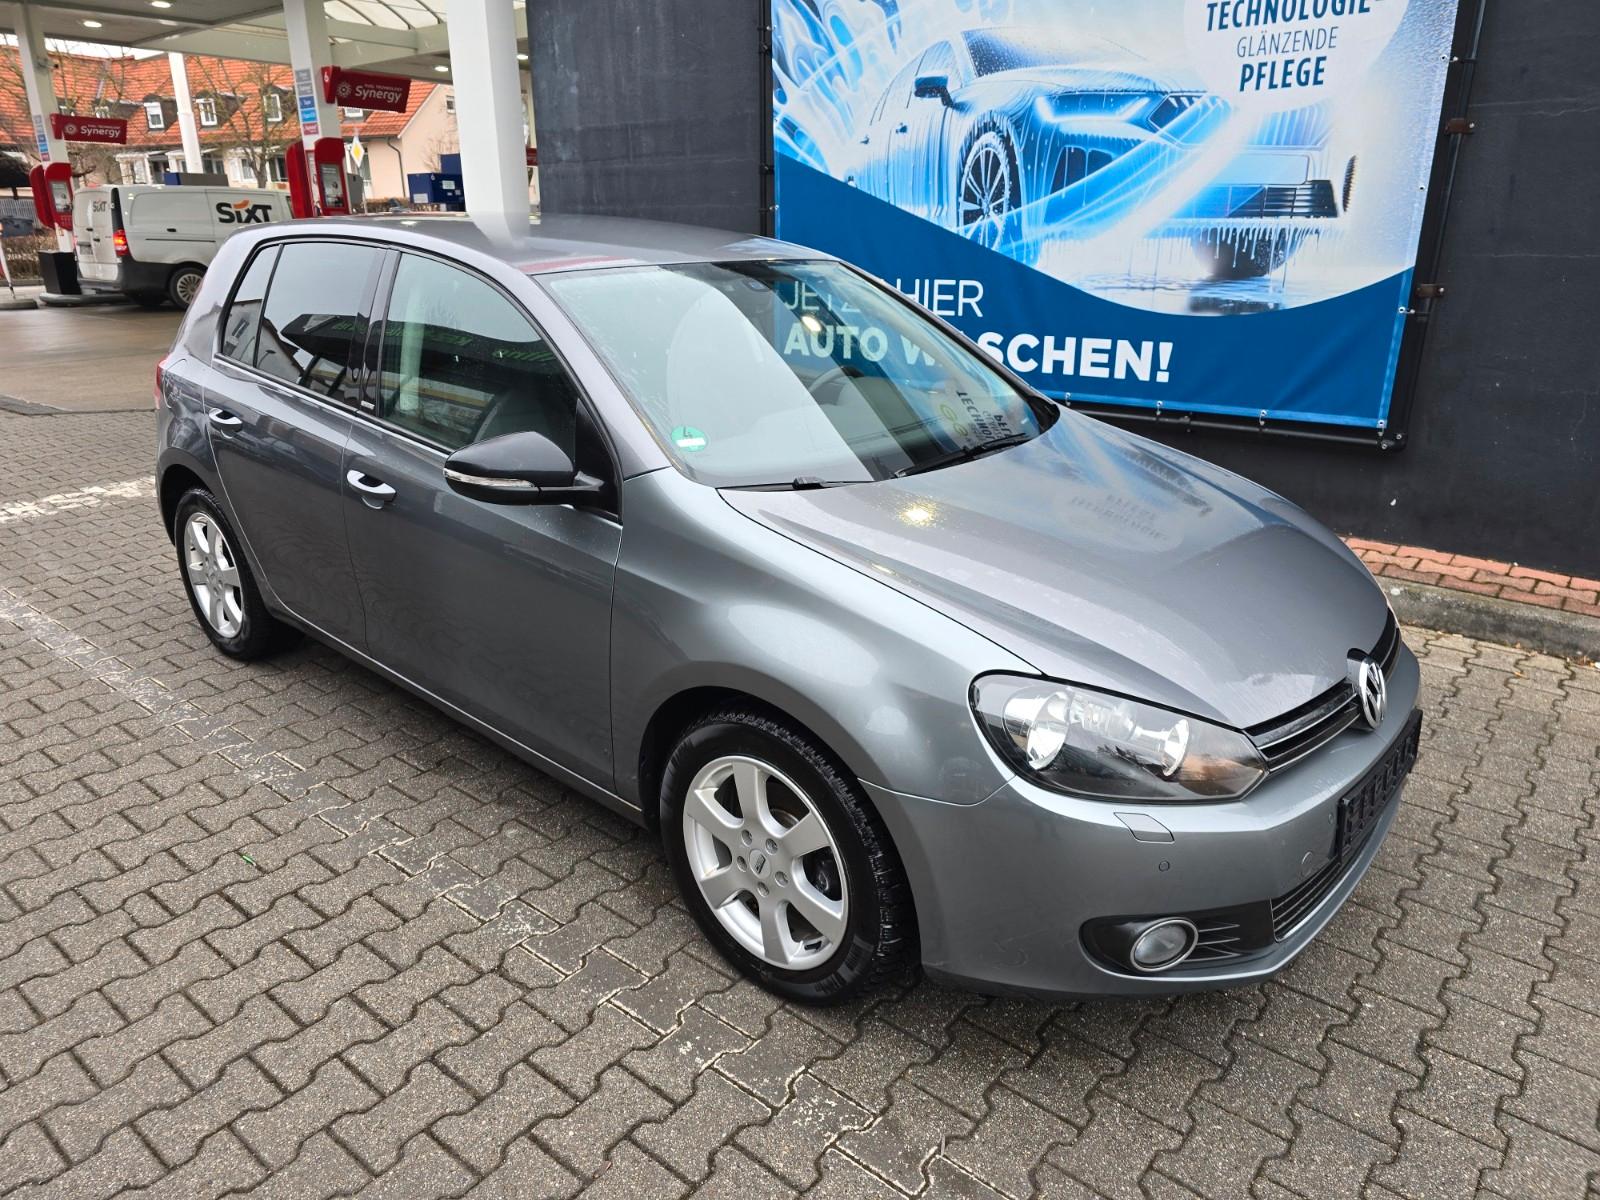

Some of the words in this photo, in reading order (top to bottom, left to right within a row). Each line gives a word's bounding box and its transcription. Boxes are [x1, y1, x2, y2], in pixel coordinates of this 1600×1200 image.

[1237, 26, 1339, 58] GLÄNZENDE
[1239, 56, 1327, 92] PFLEGE
[355, 85, 402, 104] Synergy
[80, 125, 121, 138] Synergy
[896, 278, 984, 318] HIER
[783, 322, 889, 362] AUTO
